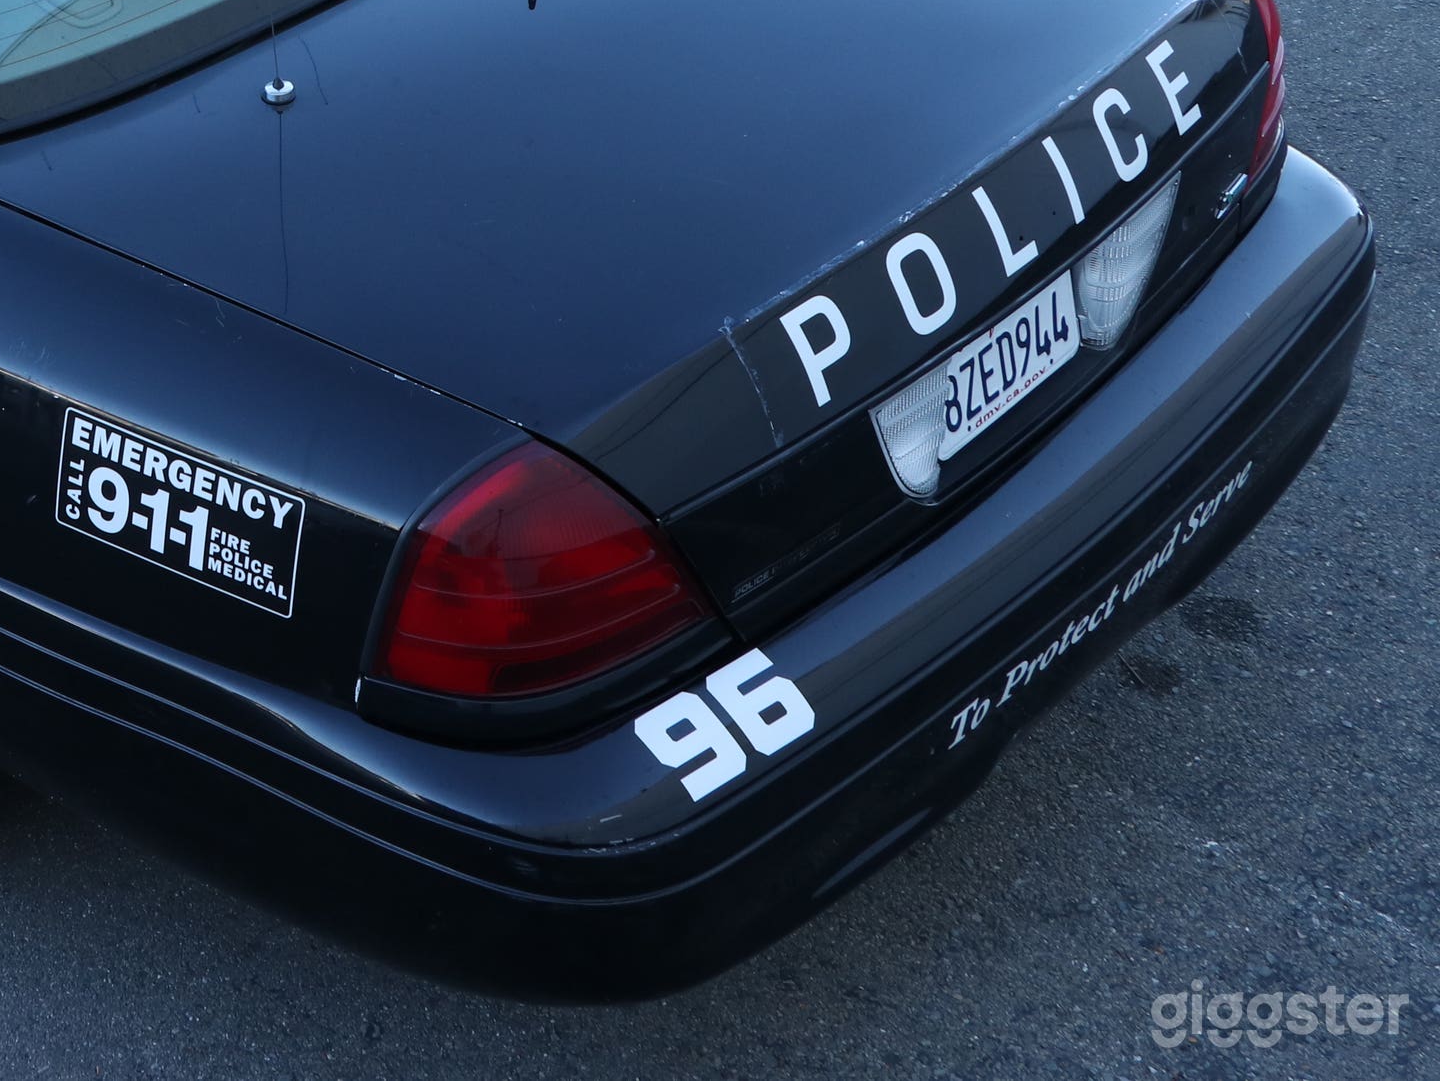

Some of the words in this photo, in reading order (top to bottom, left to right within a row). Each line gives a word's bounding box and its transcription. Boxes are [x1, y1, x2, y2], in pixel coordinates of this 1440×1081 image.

[779, 39, 1202, 408] POLICE
[944, 290, 1070, 433] 8ZED944
[975, 366, 1048, 429] dmv.ca.gov
[65, 458, 85, 520] CALL
[71, 416, 294, 529] EMERGENCY
[87, 466, 210, 572] 9-1-1
[207, 556, 288, 600] MEDICAL
[208, 541, 274, 580] POLICE
[209, 526, 251, 556] FIRE
[948, 697, 991, 750] To
[996, 584, 1120, 708] Protect
[1122, 521, 1182, 602] and
[1182, 460, 1253, 544] Serve
[634, 647, 816, 802] 96
